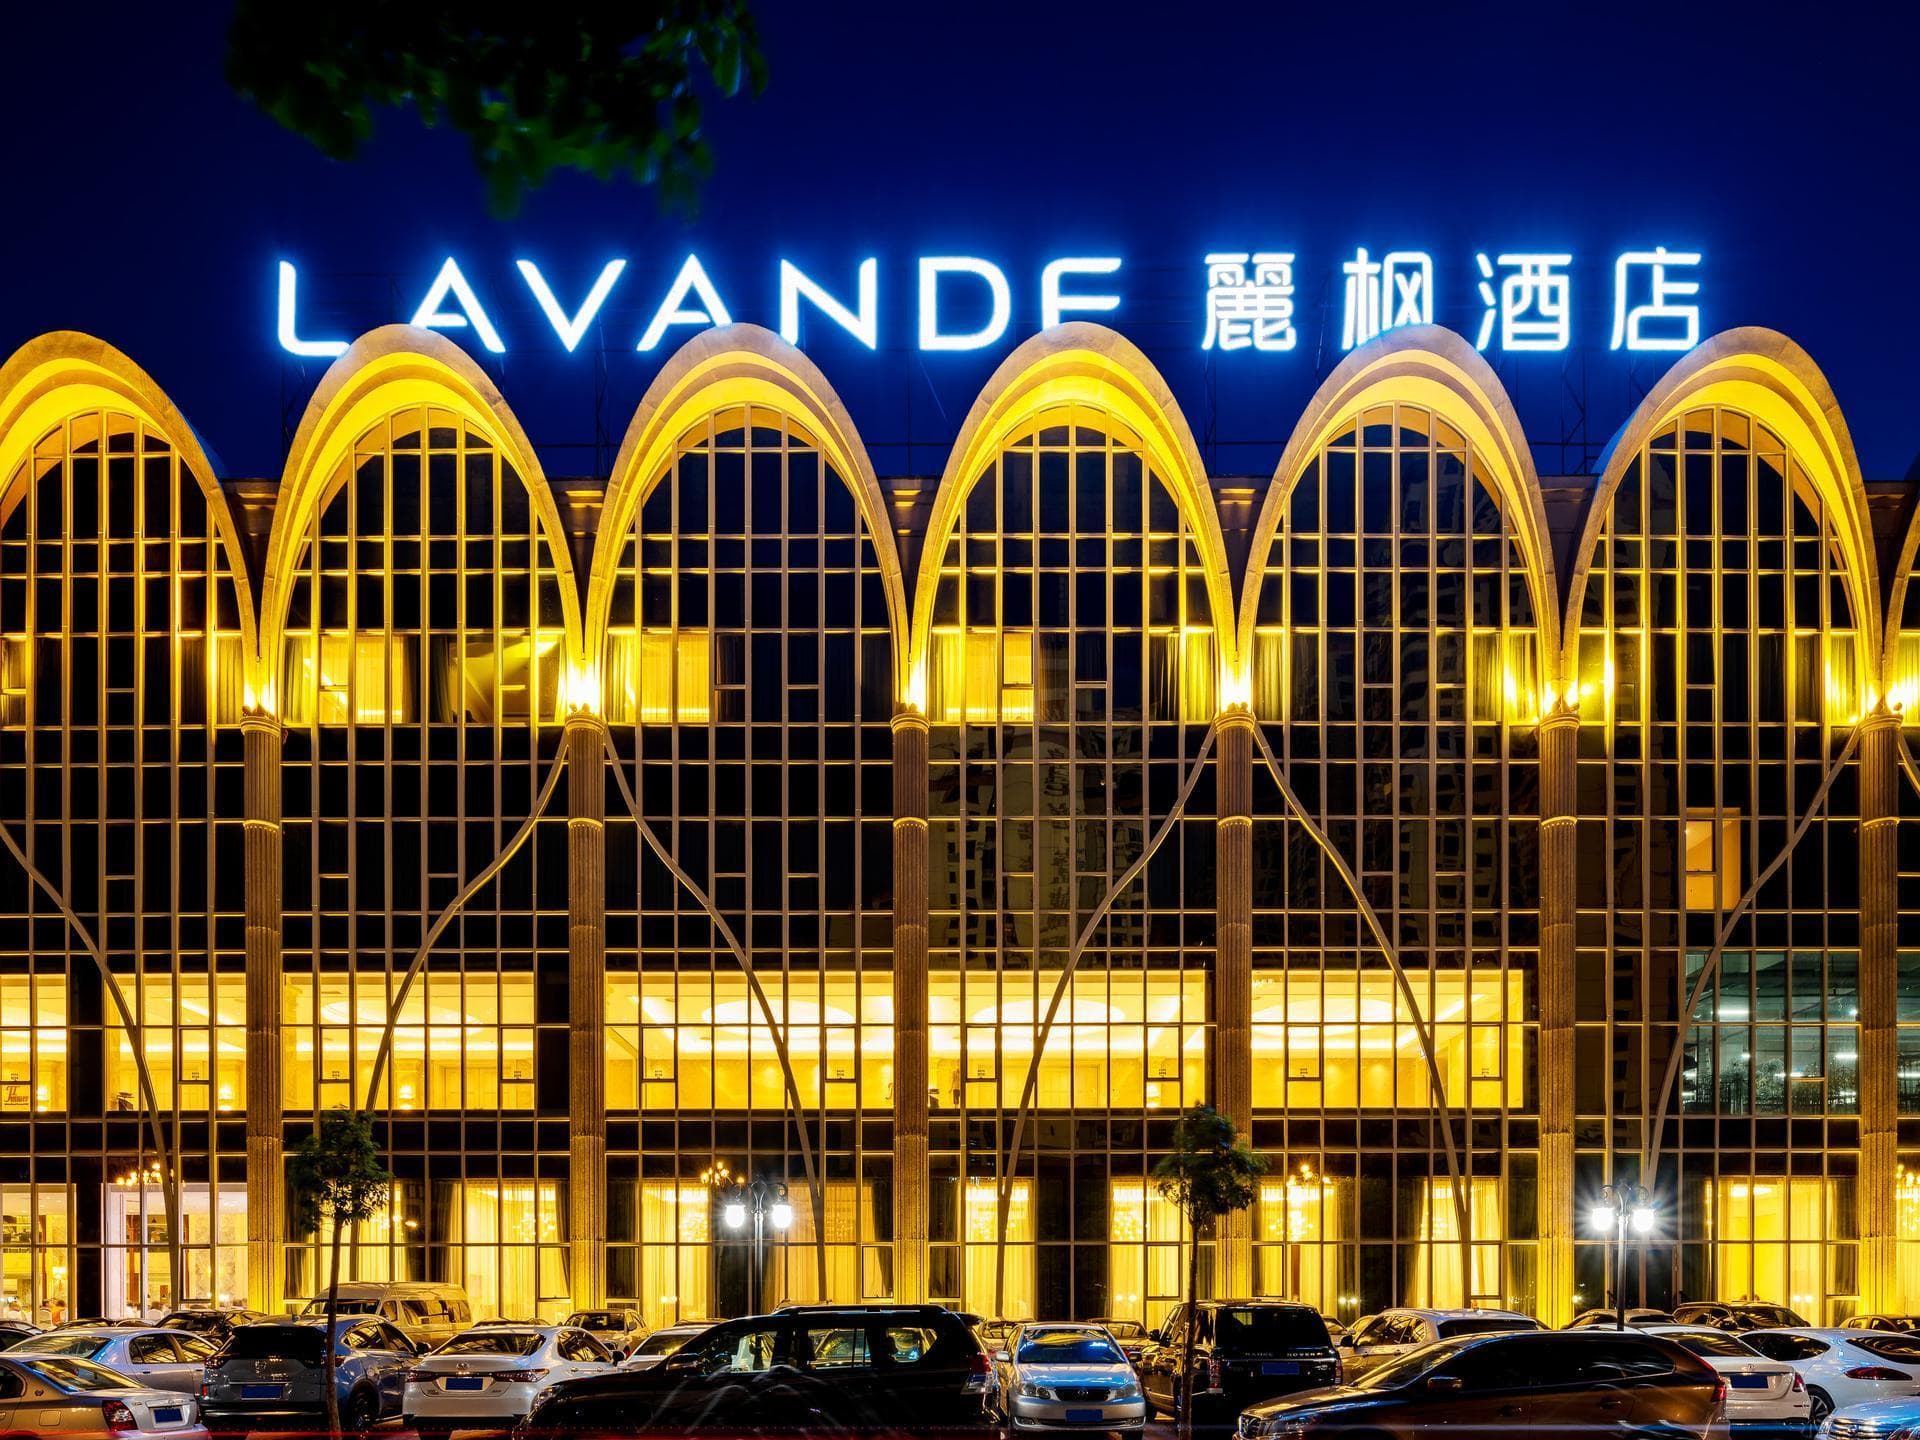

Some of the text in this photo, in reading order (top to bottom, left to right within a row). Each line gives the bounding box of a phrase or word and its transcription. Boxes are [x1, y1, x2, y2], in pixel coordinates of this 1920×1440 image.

[278, 254, 1122, 358] LAVANDE
[1201, 246, 1702, 351] 麗枫酒店
